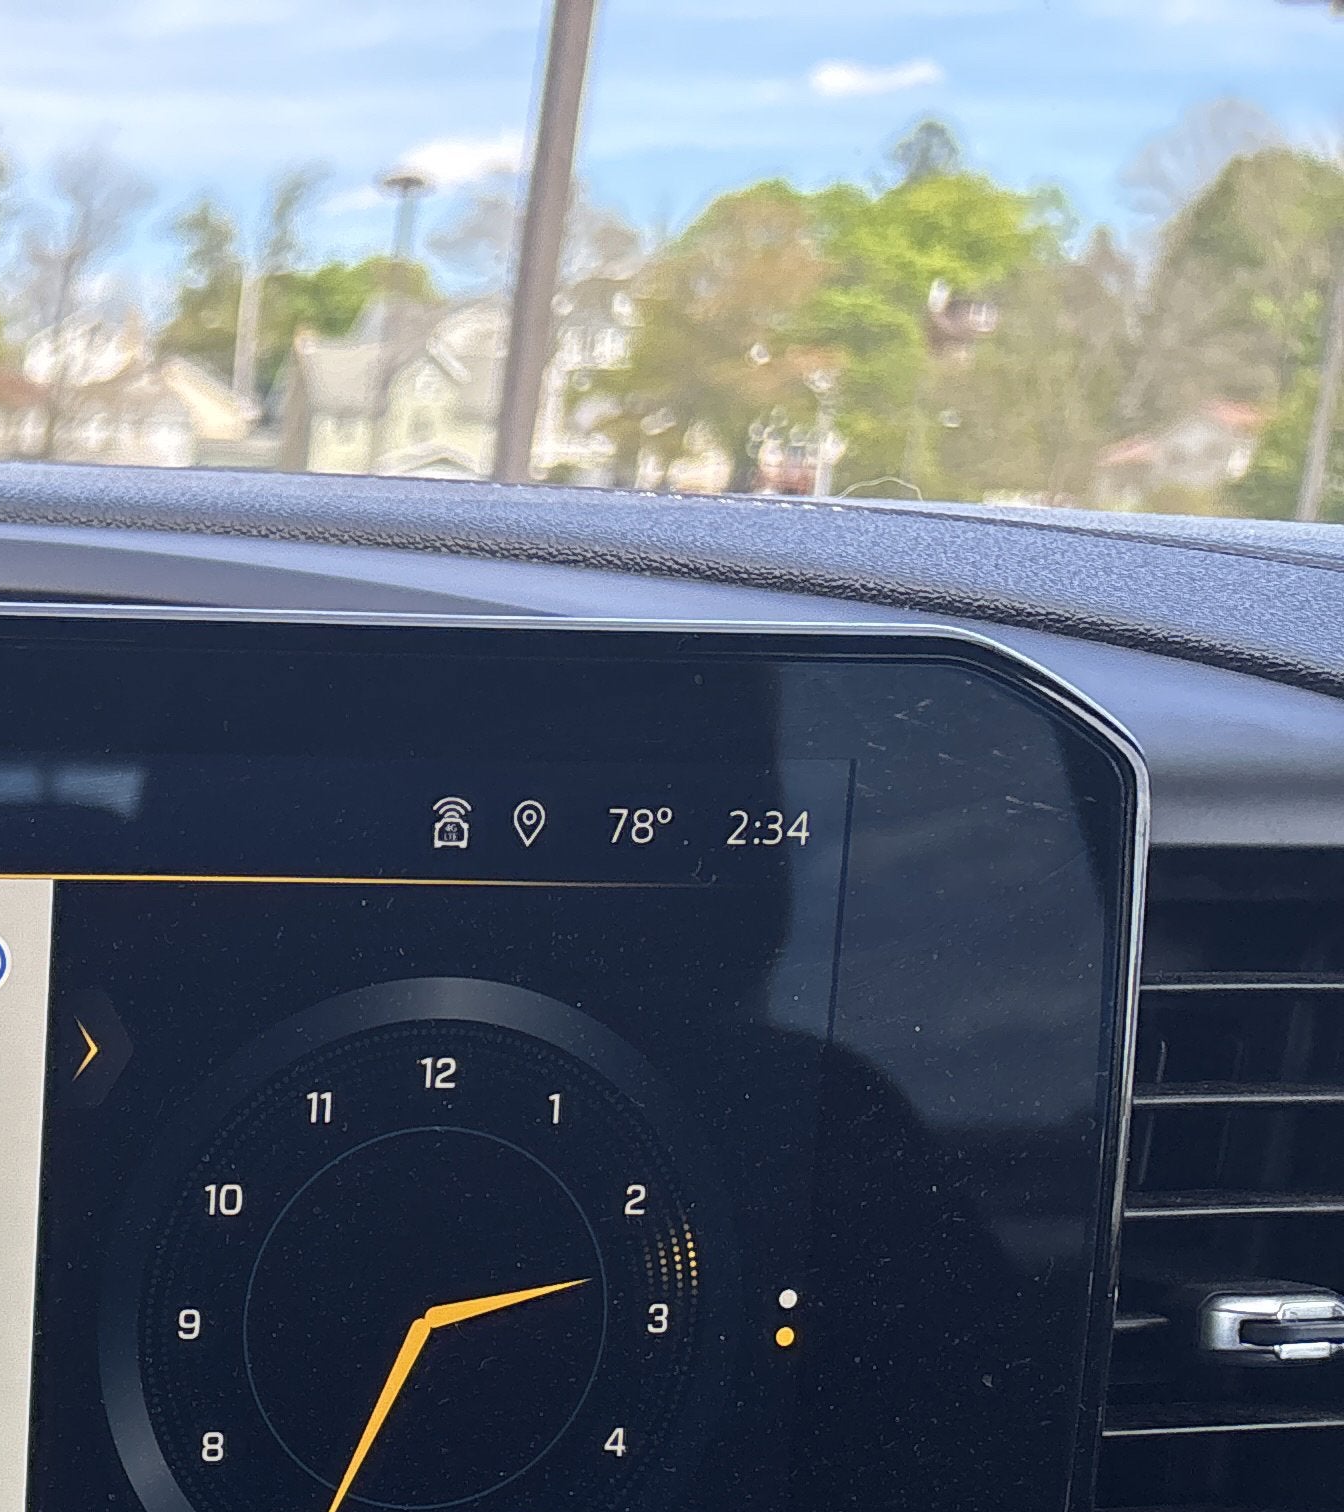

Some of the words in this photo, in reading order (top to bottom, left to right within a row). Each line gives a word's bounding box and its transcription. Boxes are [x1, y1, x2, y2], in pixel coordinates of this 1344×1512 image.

[609, 807, 673, 844] 78°
[726, 810, 810, 846] 2:34
[420, 1057, 457, 1089] 12
[306, 1091, 333, 1124] 11
[548, 1093, 562, 1124] 1
[204, 1184, 243, 1216] 10
[624, 1184, 647, 1215] 2
[177, 1308, 201, 1340] 9
[647, 1303, 669, 1334] 3
[201, 1431, 224, 1462] 8
[604, 1427, 627, 1457] 4
